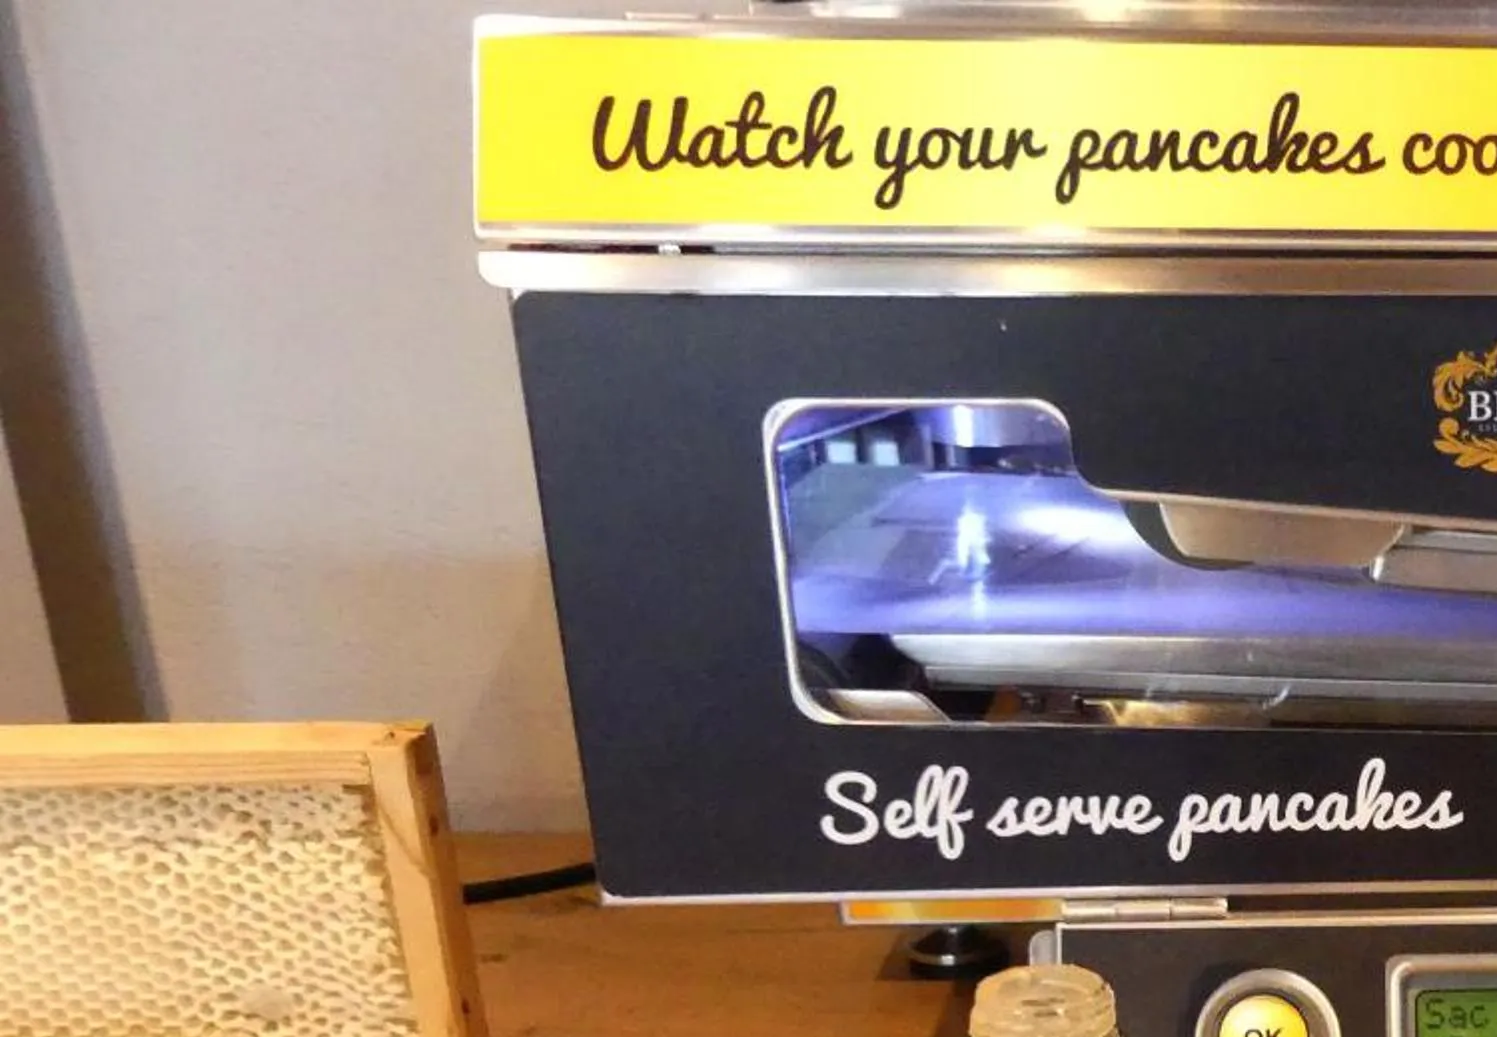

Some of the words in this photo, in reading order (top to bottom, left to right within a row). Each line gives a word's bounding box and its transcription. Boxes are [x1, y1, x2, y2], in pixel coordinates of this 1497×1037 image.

[592, 86, 852, 171] Watch
[872, 129, 1047, 210] your
[1055, 92, 1386, 205] pancakes
[820, 764, 974, 860] Self
[986, 793, 1164, 836] serve
[1167, 757, 1465, 862] pancakes
[1425, 998, 1489, 1030] Sac
